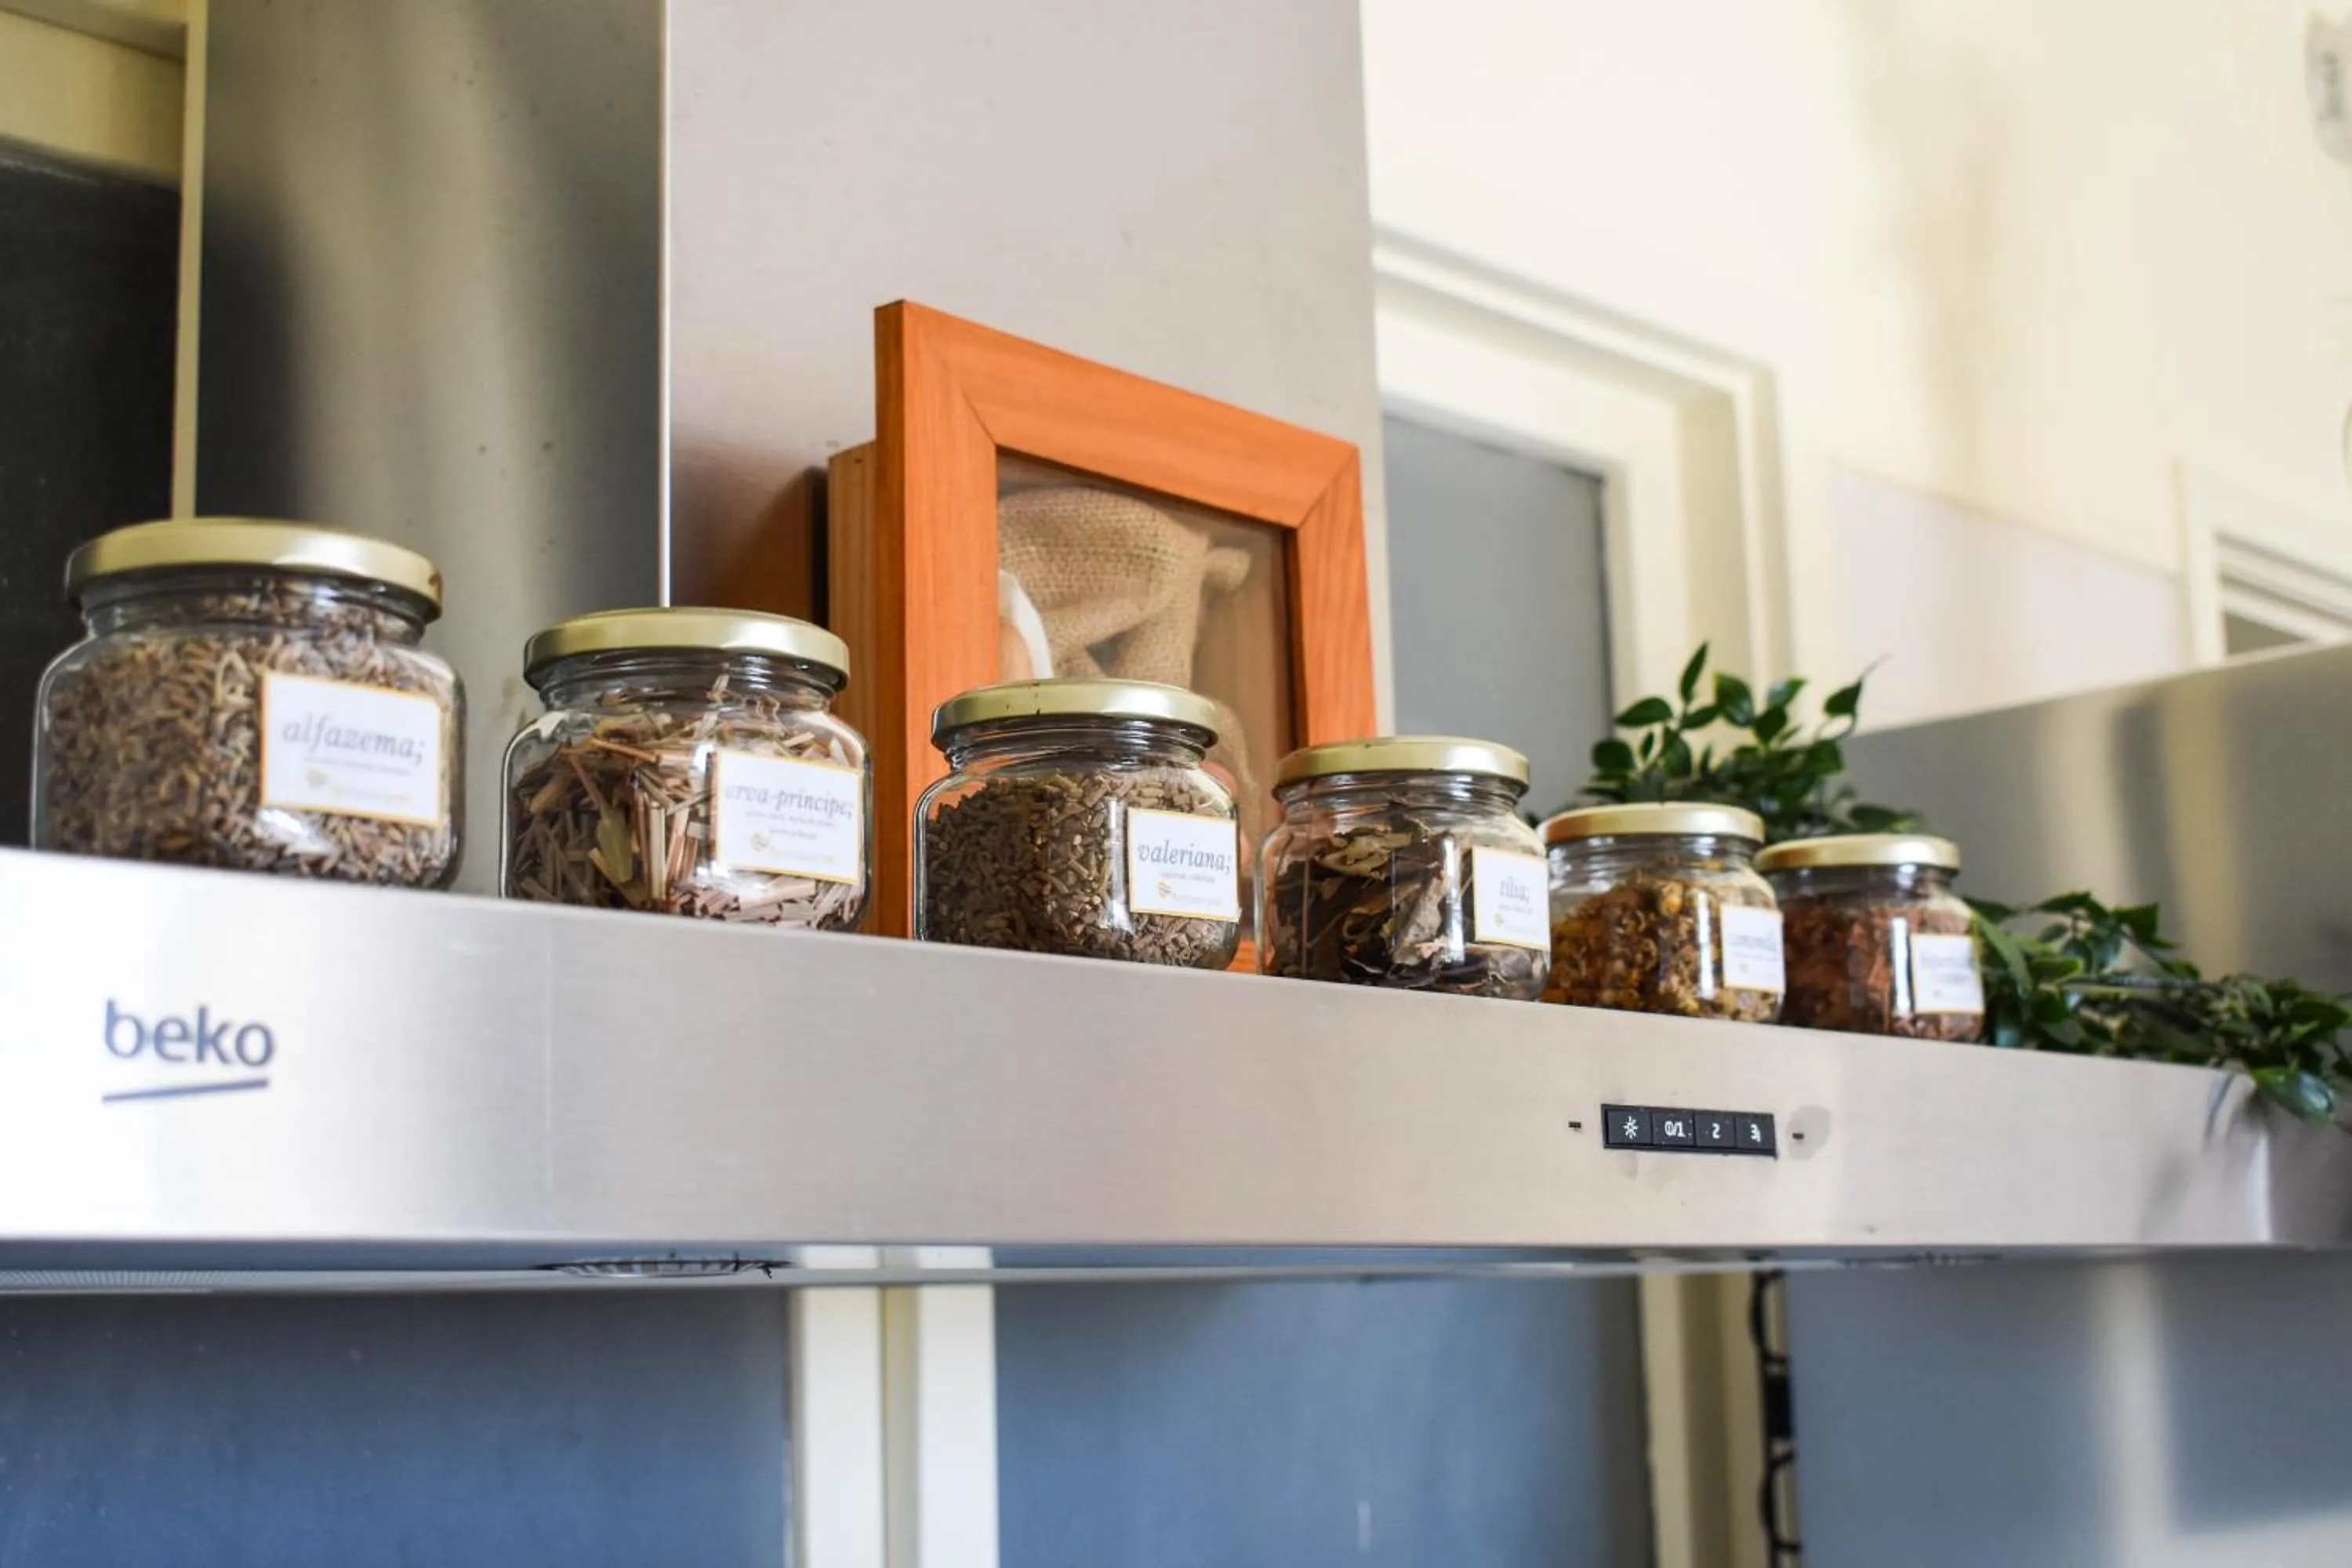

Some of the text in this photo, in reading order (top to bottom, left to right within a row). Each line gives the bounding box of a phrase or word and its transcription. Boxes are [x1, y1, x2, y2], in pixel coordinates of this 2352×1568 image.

[1137, 839, 1232, 876] valeriana;
[103, 998, 275, 1068] beko
[1711, 1122, 1722, 1139] 2
